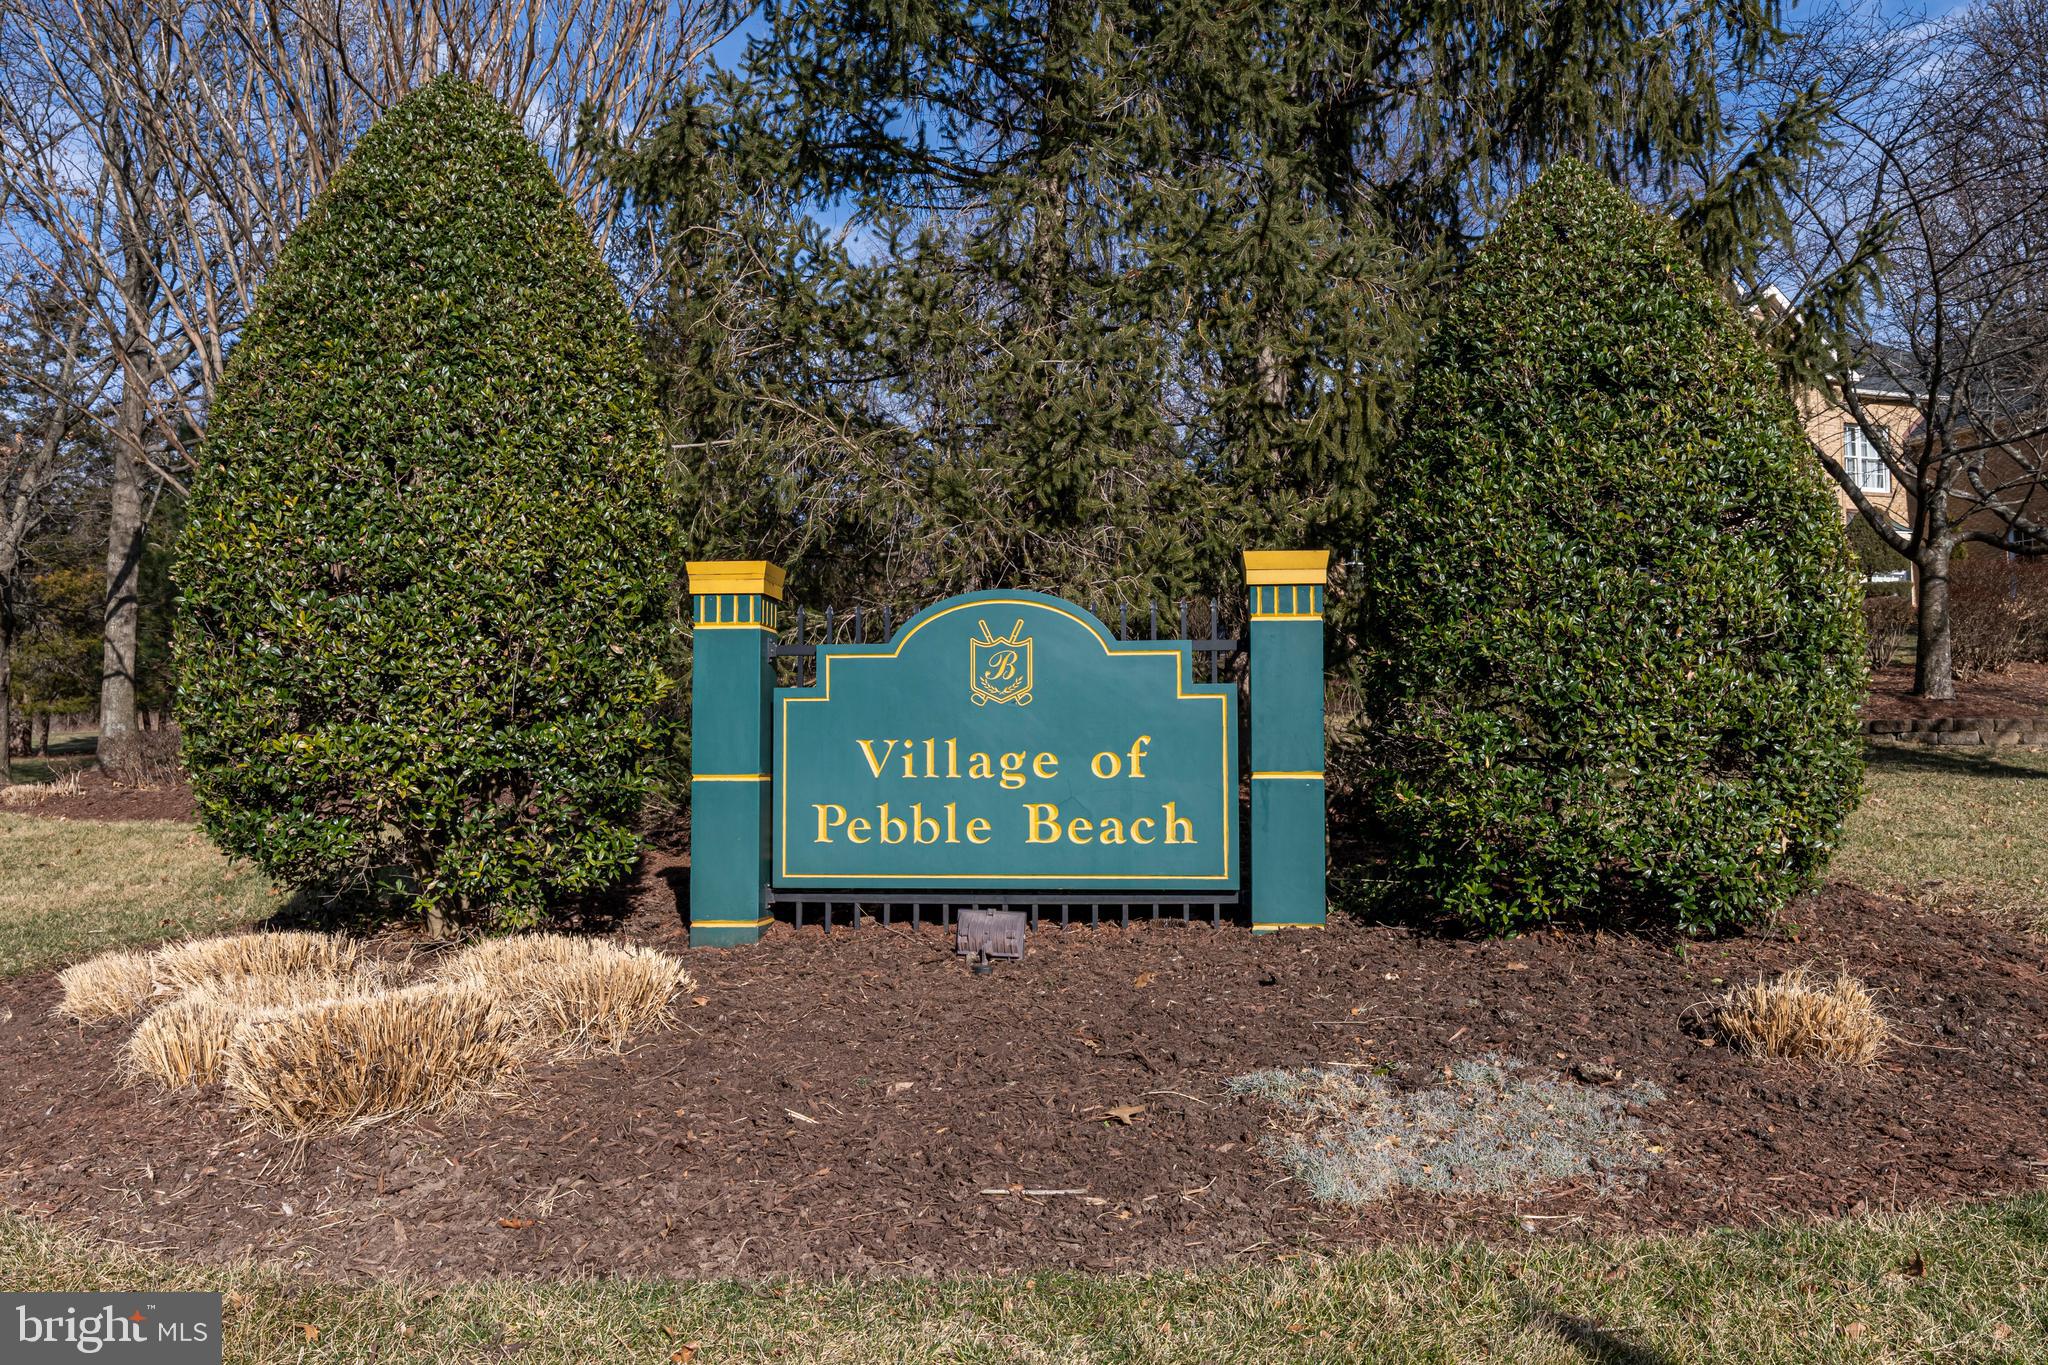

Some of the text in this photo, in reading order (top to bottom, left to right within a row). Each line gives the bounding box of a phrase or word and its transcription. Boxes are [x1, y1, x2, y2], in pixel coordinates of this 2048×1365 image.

[984, 649, 1018, 680] B
[856, 735, 1152, 790] Village of
[812, 800, 1198, 845] Pebble Beach
